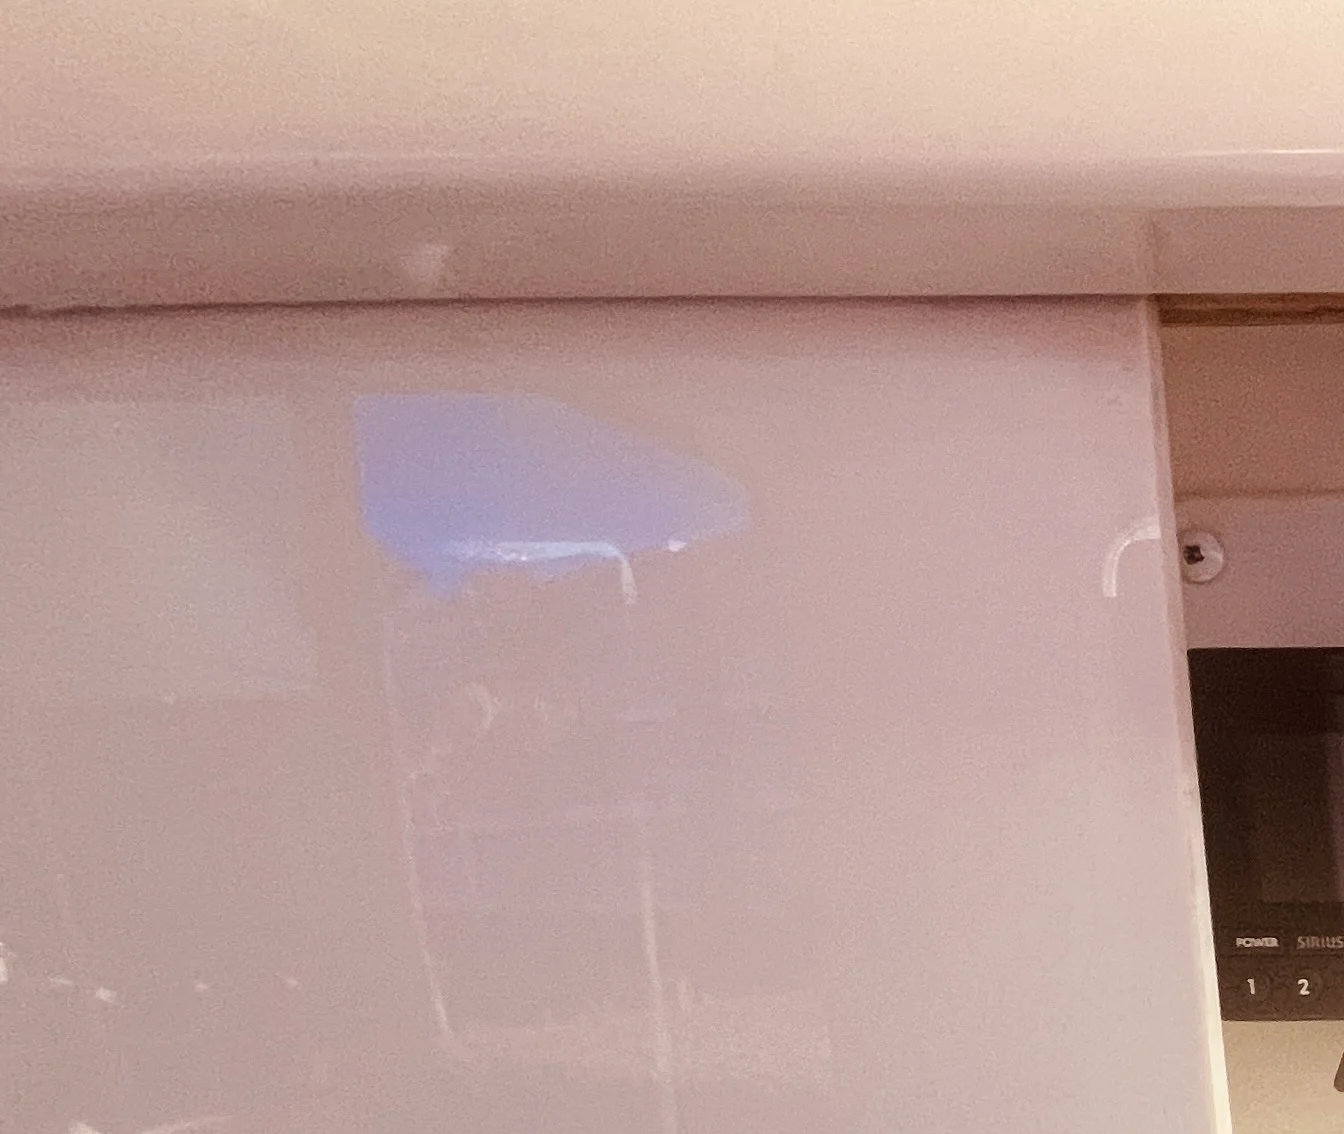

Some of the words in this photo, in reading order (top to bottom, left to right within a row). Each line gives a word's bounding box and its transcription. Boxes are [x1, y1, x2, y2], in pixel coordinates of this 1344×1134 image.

[1236, 937, 1279, 948] POWER
[1247, 978, 1256, 995] 1
[1298, 978, 1310, 996] 2
